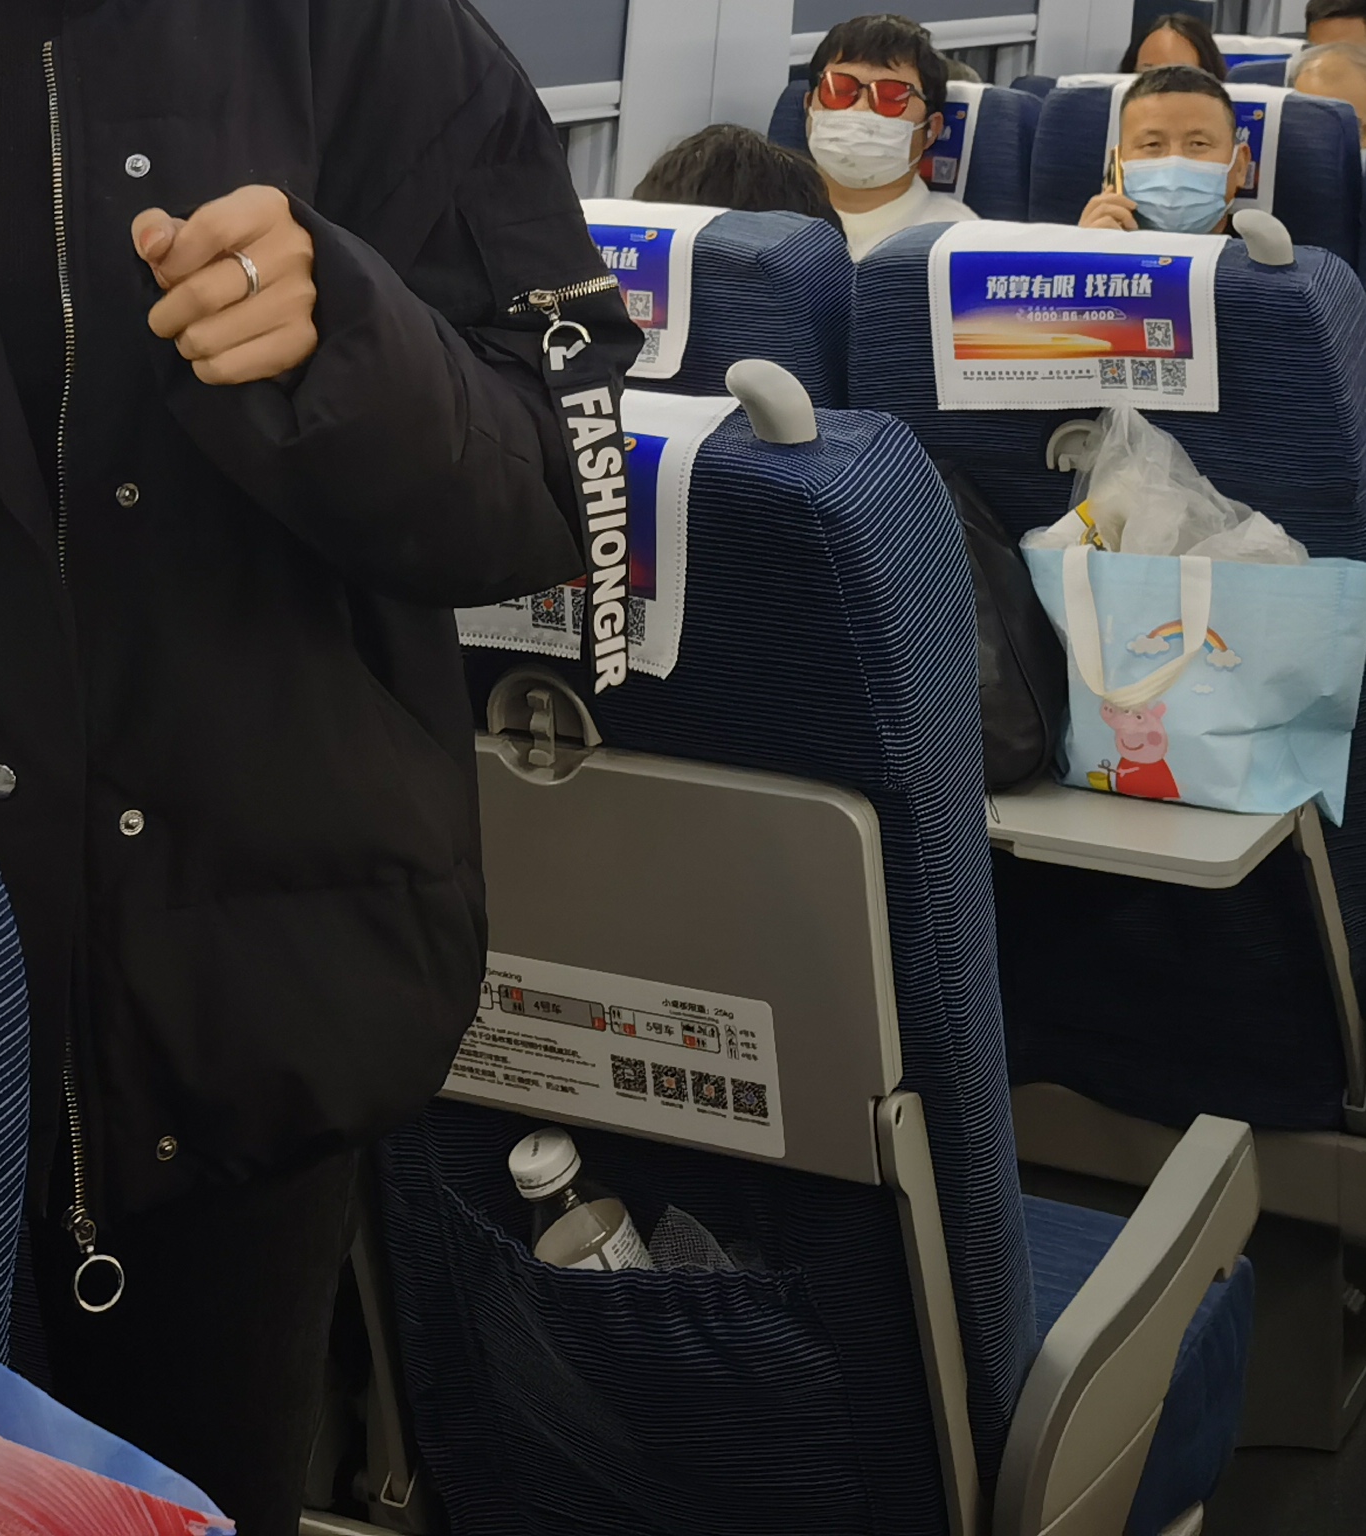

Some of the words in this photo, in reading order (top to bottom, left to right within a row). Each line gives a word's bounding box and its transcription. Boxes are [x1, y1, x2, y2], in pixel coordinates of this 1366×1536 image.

[597, 245, 640, 271] 永达
[985, 274, 1076, 300] 预算有限
[1084, 272, 1153, 298] 找永达
[561, 386, 628, 695] FASHIONGIR
